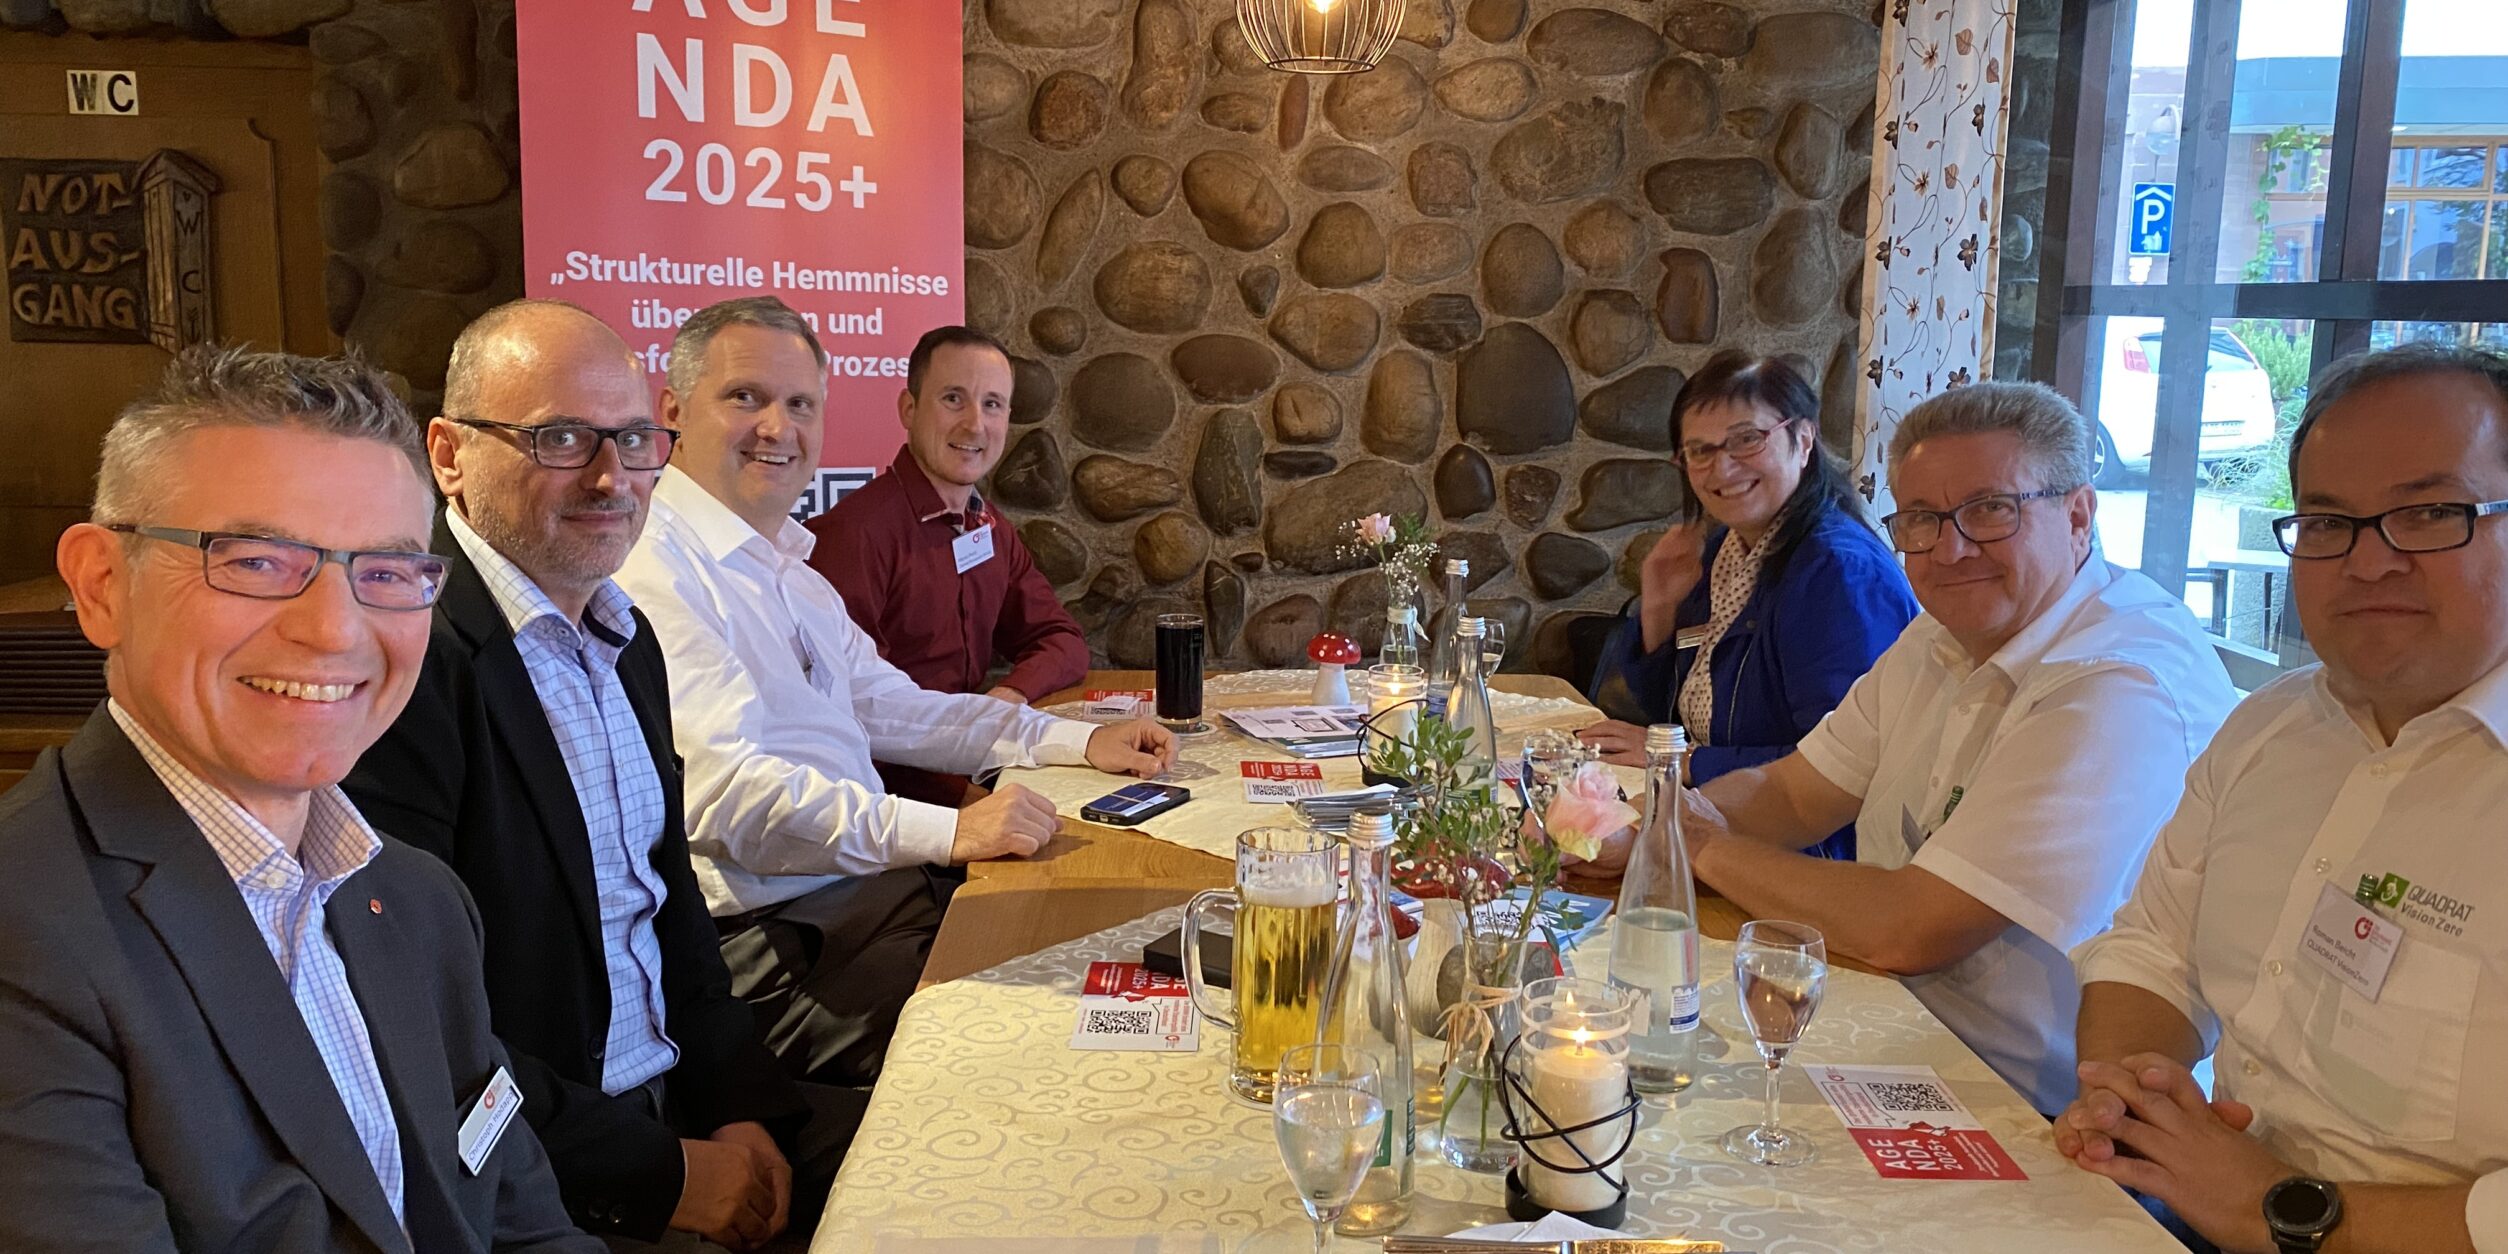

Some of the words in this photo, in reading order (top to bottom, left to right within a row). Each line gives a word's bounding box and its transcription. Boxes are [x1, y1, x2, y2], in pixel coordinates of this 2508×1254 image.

[70, 73, 135, 112] WC
[636, 32, 874, 137] NDA
[643, 138, 877, 212] 2025+
[17, 174, 133, 214] NOT-
[2141, 199, 2165, 234] P
[10, 228, 140, 273] AUS-
[550, 251, 764, 289] „Strukturelle
[773, 261, 949, 296] Hemmnisse
[13, 283, 138, 329] GANG
[828, 308, 882, 335] und
[824, 351, 909, 377] rozes
[2401, 901, 2435, 926] Vision
[2435, 917, 2463, 937] Zero
[2408, 885, 2474, 922] QUADRAT
[2306, 938, 2338, 966] QUADRAT
[468, 1122, 494, 1161] Christoph
[1867, 1139, 1912, 1170] AGE
[1897, 1139, 1941, 1170] NDA
[1927, 1139, 1964, 1170] 2025+
